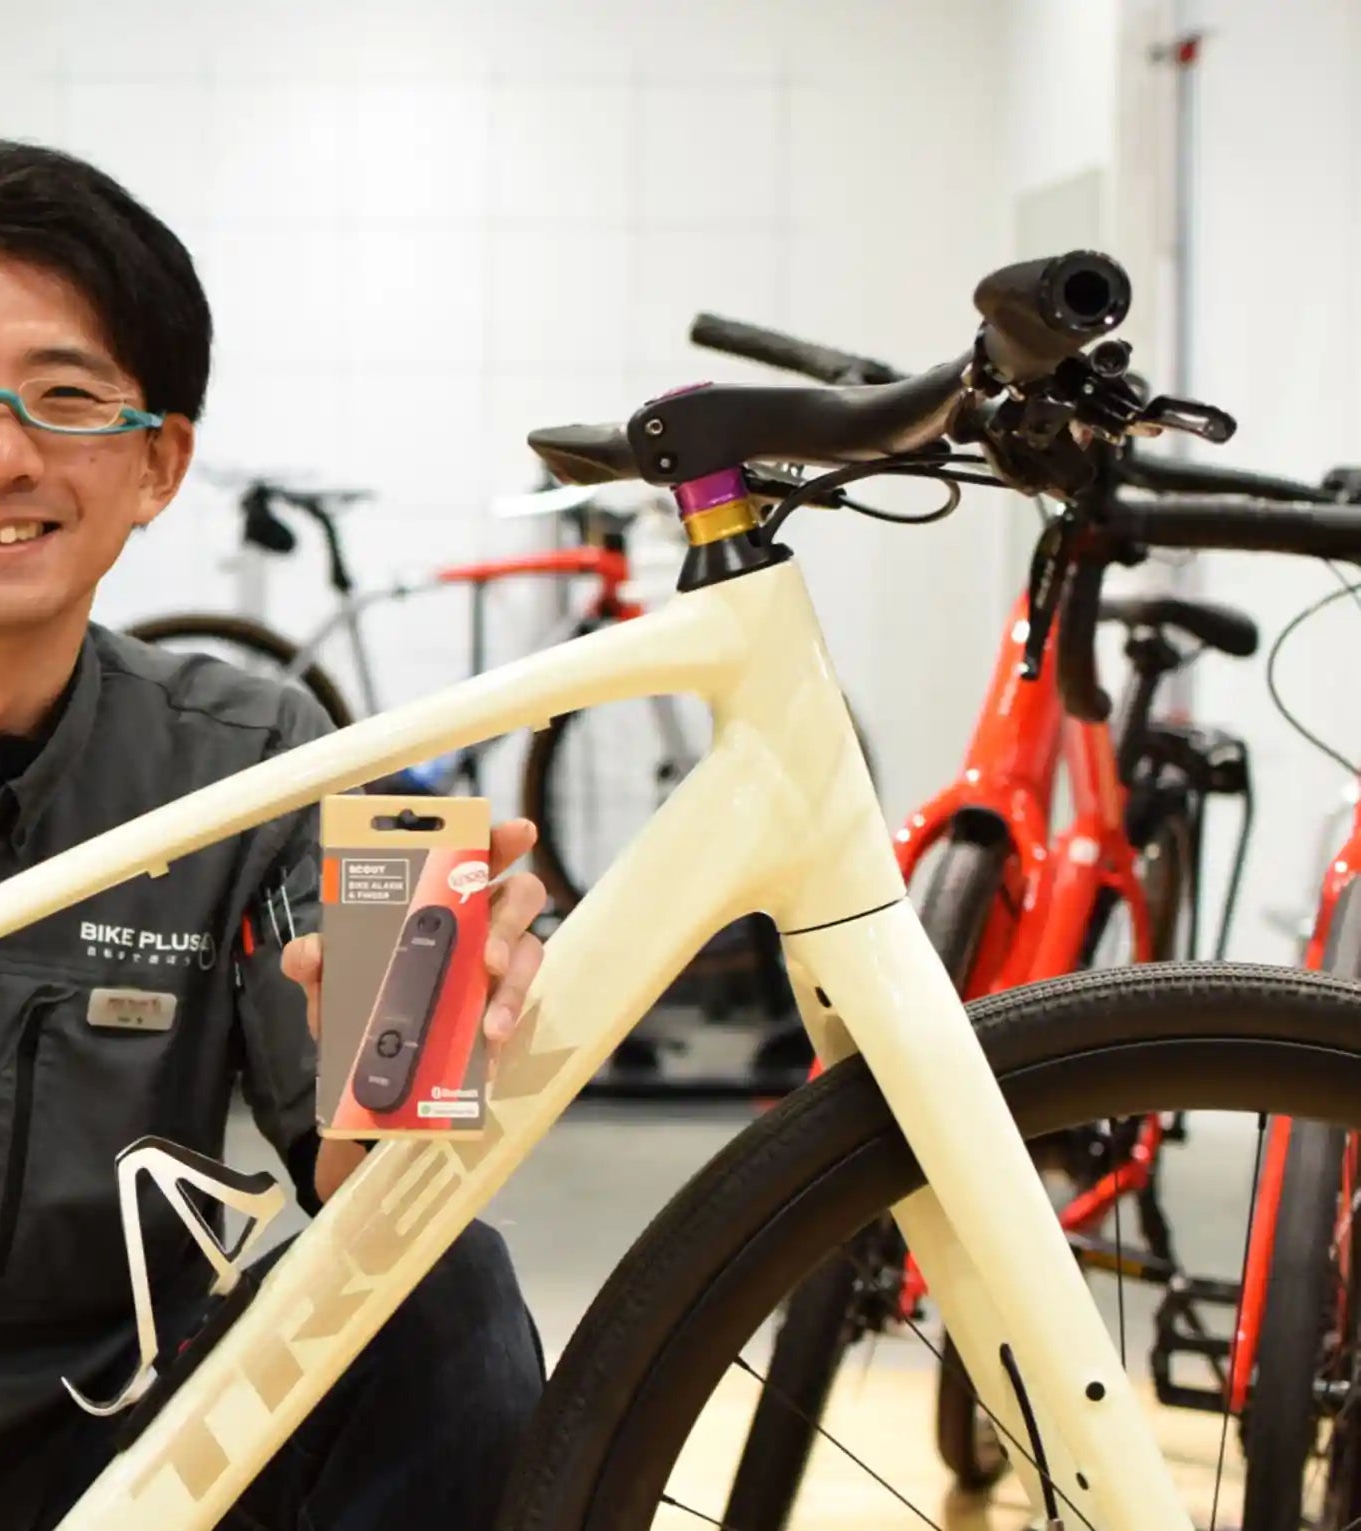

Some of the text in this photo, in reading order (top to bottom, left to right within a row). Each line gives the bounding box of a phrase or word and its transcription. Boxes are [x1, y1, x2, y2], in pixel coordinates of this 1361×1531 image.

[348, 864, 387, 874] SCOUT
[80, 921, 201, 952] BIKE PLUS
[131, 996, 581, 1502] TREK
